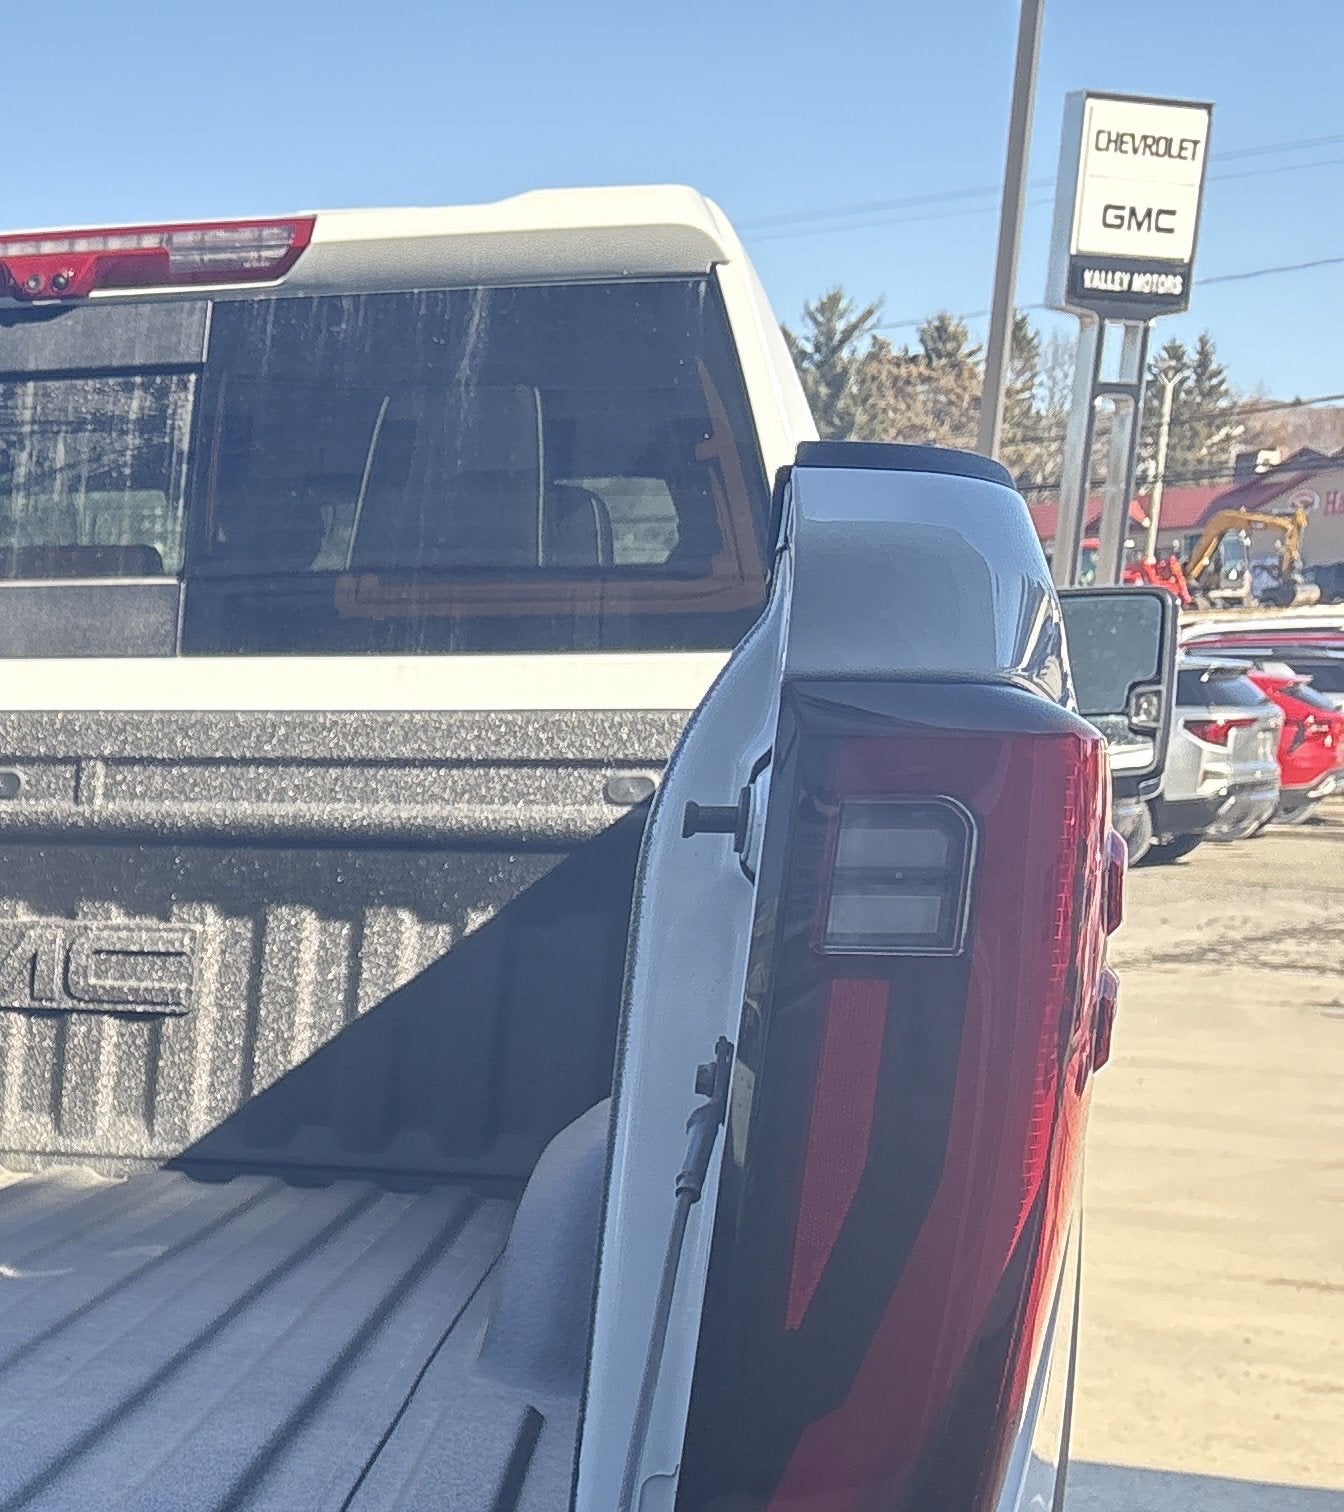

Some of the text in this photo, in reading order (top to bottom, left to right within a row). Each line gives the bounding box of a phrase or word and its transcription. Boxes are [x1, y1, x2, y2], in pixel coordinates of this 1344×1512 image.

[1094, 129, 1201, 162] CHEVROLET
[1101, 203, 1177, 234] GMC
[1083, 268, 1183, 296] VALLEY MOTORS
